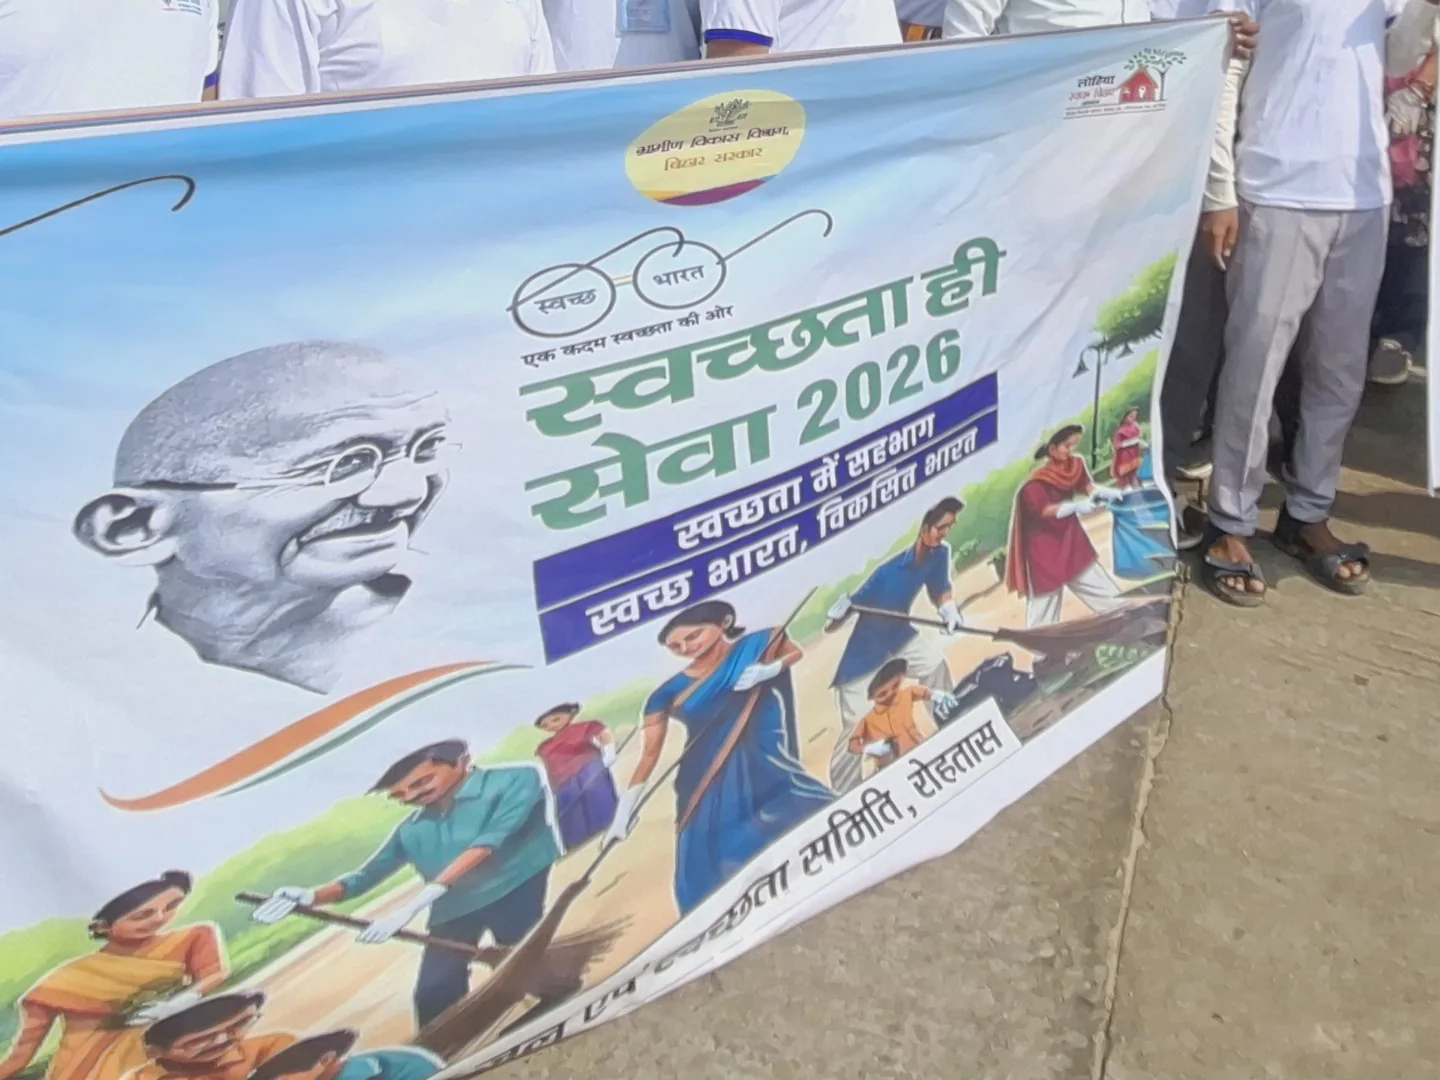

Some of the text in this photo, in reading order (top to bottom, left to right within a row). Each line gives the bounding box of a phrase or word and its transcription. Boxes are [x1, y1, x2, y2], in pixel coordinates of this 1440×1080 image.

[690, 131, 741, 149] विकास
[714, 147, 763, 164] सरकार
[519, 236, 1008, 439] स्वच्छता ही
[520, 305, 735, 368] एक कदम स्वच्छता की ओर
[534, 264, 705, 315] स्वच्छ भारत
[524, 329, 964, 532] सेवा 2026
[673, 411, 936, 551] स्वच्छता में सहभाग
[585, 425, 979, 637] स्वच्छ भारत, विकसित भारत
[799, 787, 918, 877] समिति,
[907, 719, 1003, 799] रोहतास
